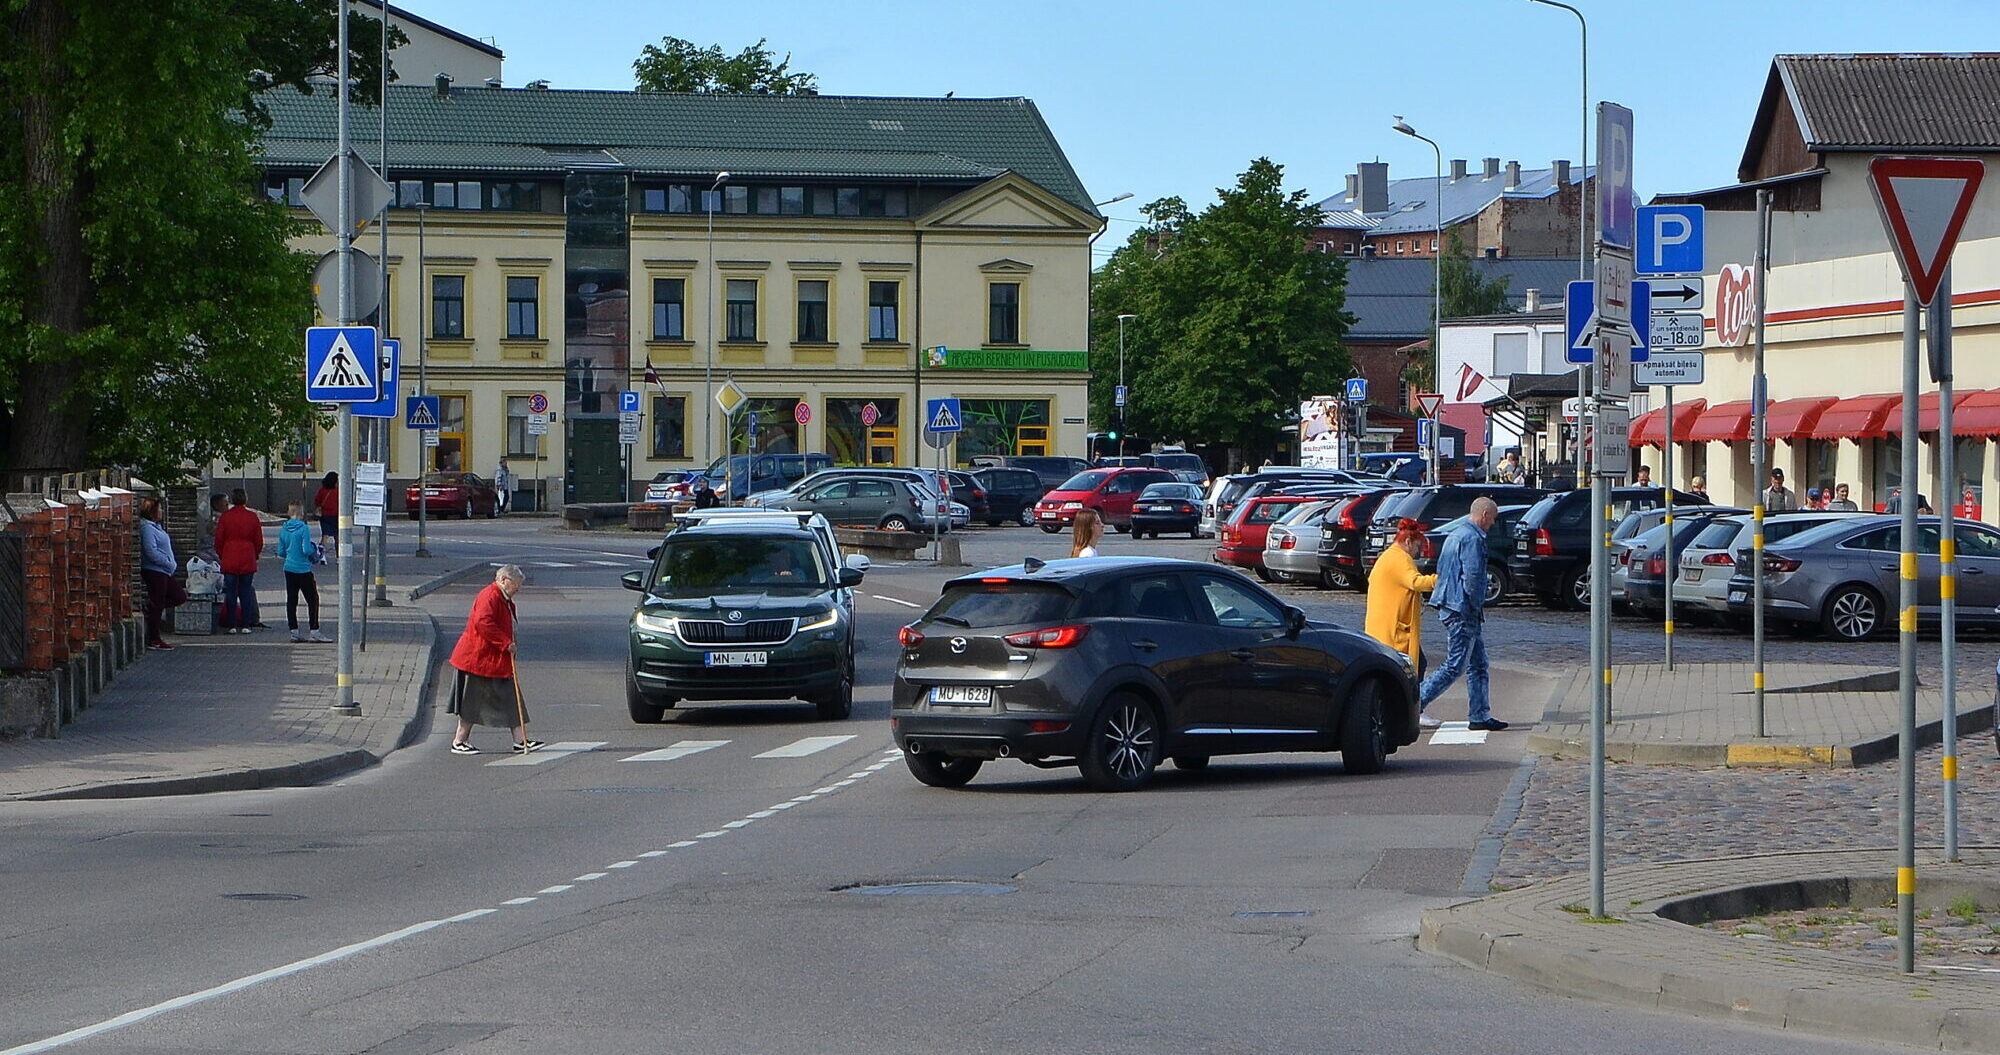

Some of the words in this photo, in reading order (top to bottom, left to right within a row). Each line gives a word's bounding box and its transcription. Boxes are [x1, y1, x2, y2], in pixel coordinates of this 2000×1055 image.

[1611, 123, 1628, 229] P
[1653, 213, 1692, 267] P
[624, 393, 636, 410] P
[744, 652, 765, 664] 414
[938, 686, 989, 700] MU-1628
